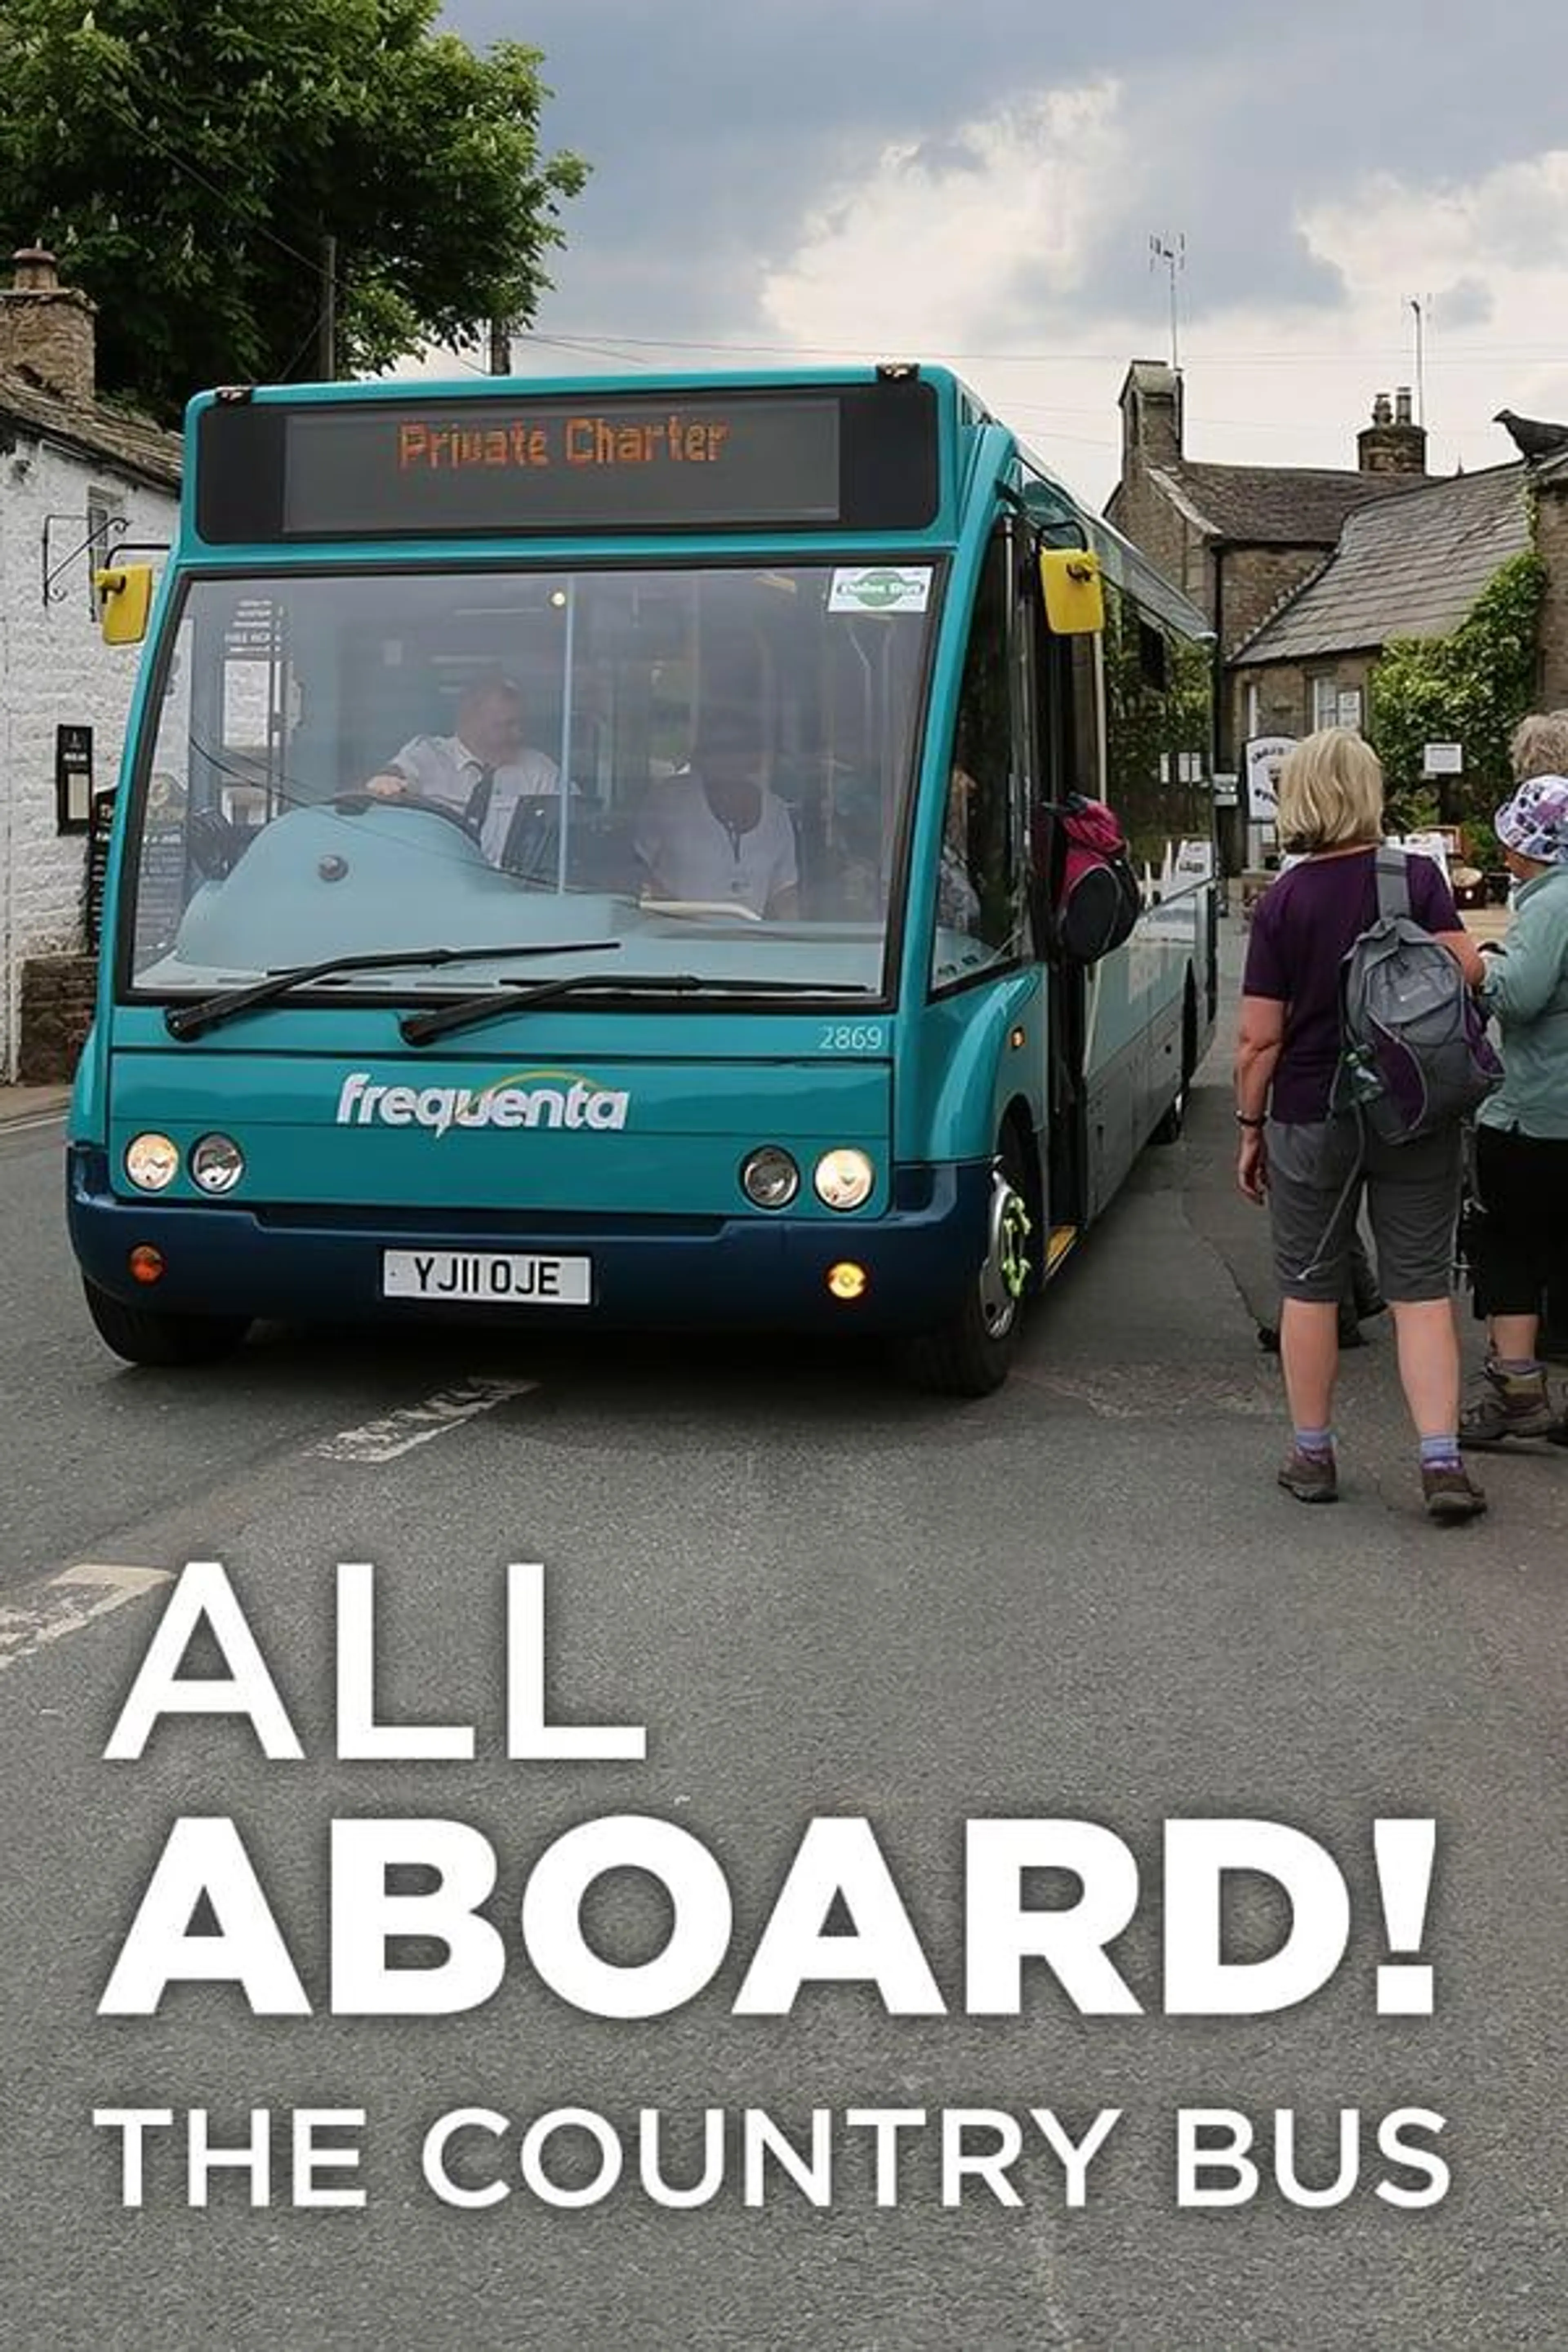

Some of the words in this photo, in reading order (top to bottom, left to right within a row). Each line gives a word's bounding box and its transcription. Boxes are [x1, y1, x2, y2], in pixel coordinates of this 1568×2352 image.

[399, 423, 548, 467] Private
[566, 416, 727, 464] Charter
[820, 1025, 882, 1049] 2869
[337, 1074, 628, 1137] frequenta
[491, 1260, 560, 1295] OJE
